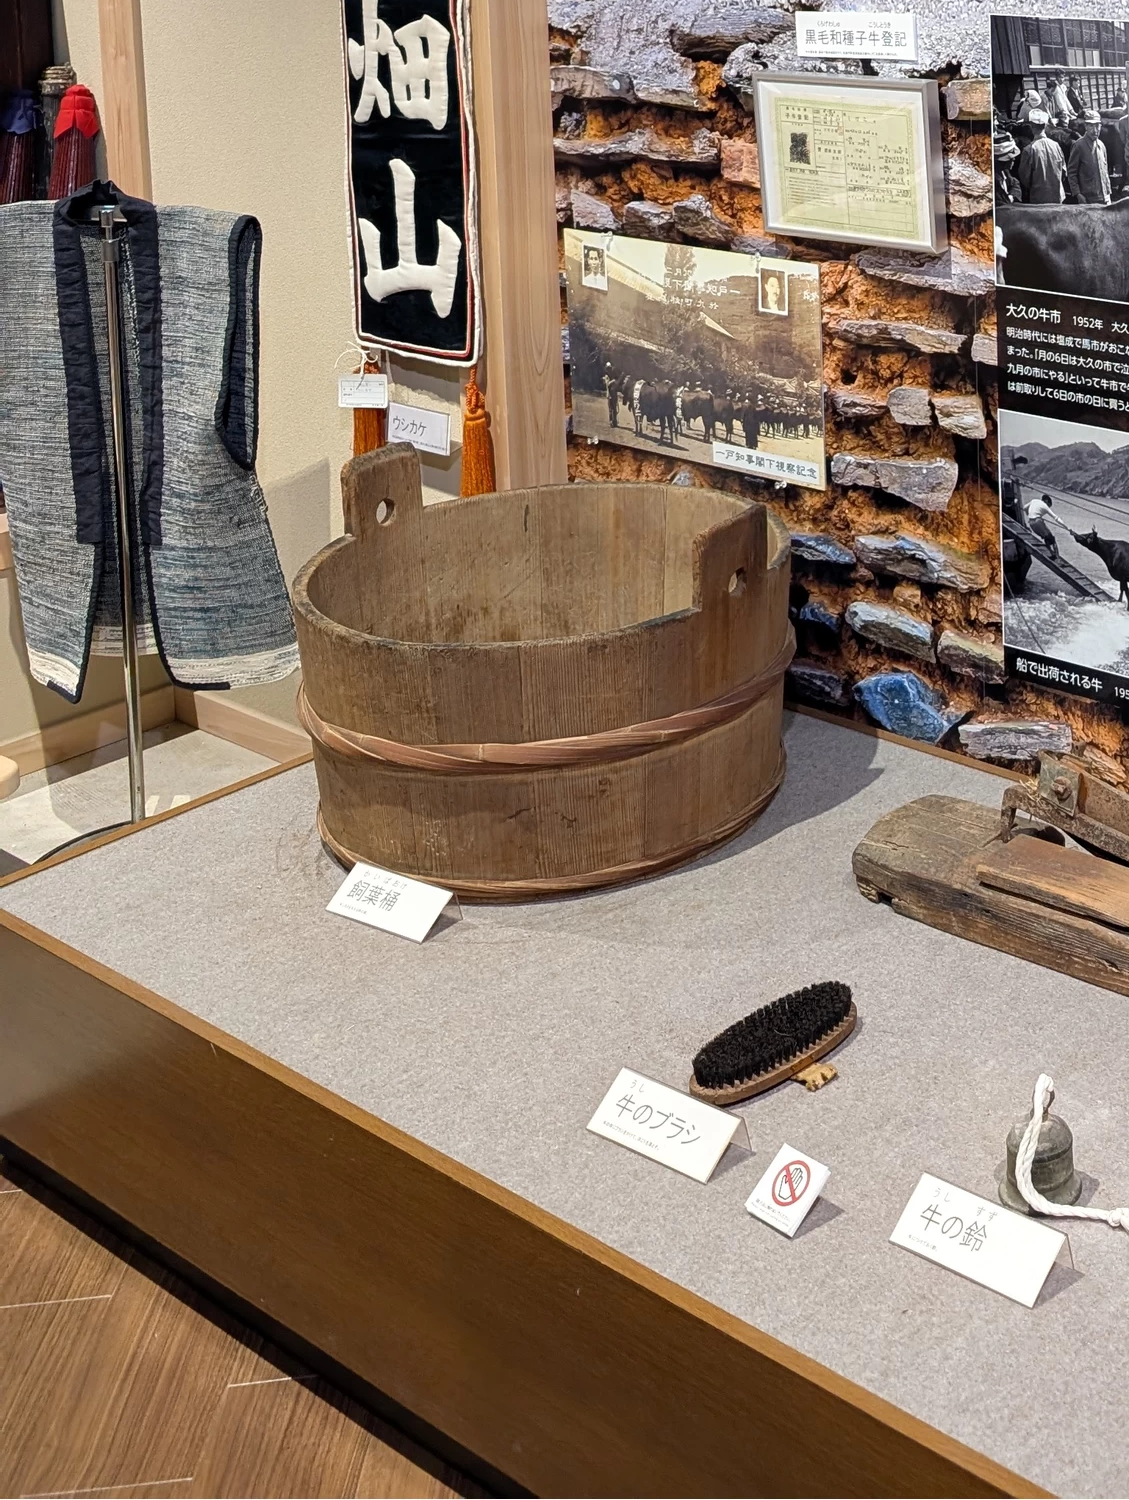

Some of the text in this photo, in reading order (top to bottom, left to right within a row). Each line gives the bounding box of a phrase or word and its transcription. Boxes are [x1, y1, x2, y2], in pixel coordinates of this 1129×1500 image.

[805, 29, 907, 47] 黒毛和種子牛登記
[1005, 303, 1061, 324] 大久の牛市
[1072, 316, 1104, 330] 1952年
[1111, 322, 1129, 334] 大久
[393, 415, 427, 437] ウシカケ
[1016, 657, 1103, 692] 船で出荷される牛
[347, 879, 401, 912] 飼葉桶
[630, 1079, 645, 1094] うし
[615, 1093, 701, 1145] 牛のブラシ
[933, 1188, 951, 1203] うし
[976, 1206, 999, 1222] すず
[920, 1203, 988, 1252] 牛の鈴
